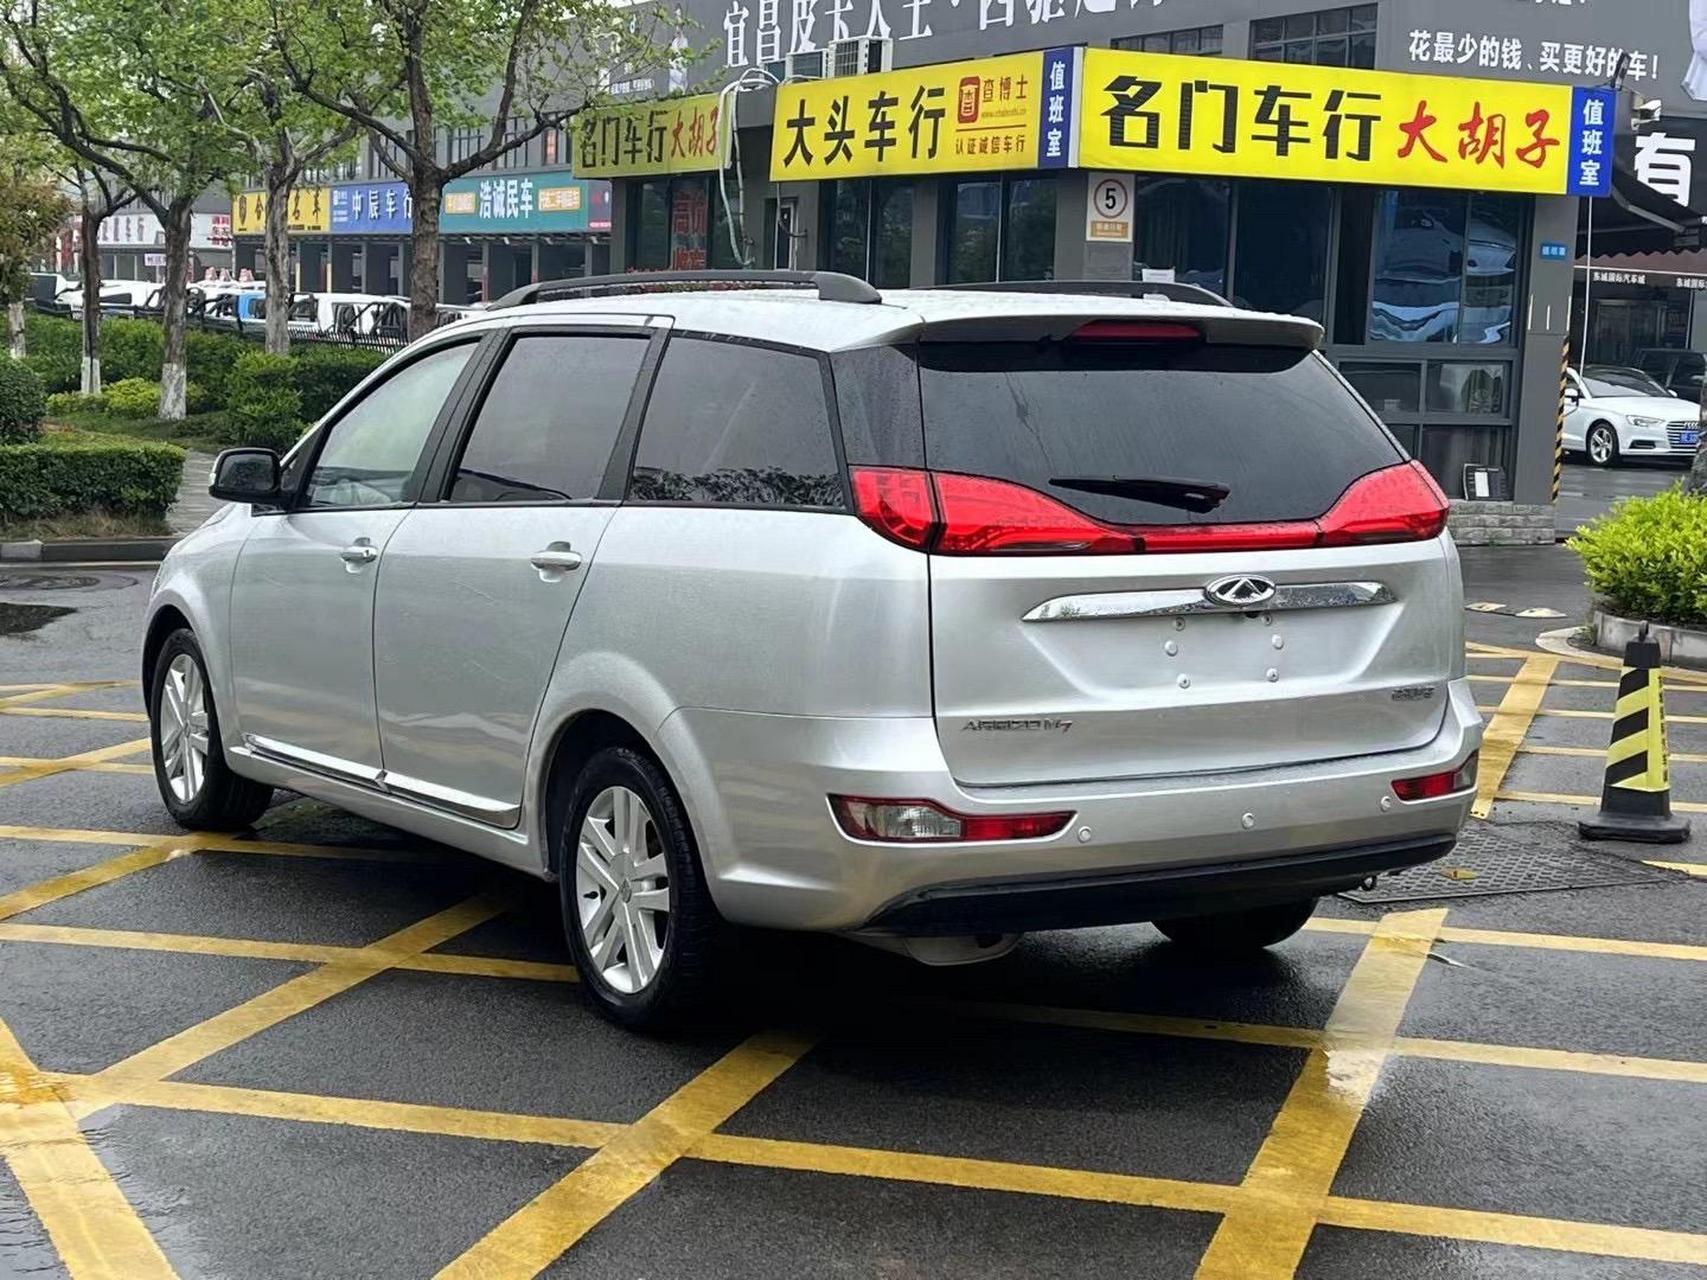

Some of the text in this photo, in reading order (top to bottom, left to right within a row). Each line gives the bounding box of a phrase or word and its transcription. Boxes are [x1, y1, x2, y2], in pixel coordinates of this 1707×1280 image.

[783, 85, 945, 167] 大头车行
[983, 74, 1029, 102] 查博士
[1046, 61, 1066, 157] 值班室
[1100, 75, 1561, 169] 名门车行 大胡子
[955, 134, 1026, 155] 认证诚信车行
[1578, 98, 1605, 186] 值班室
[1634, 132, 1696, 208] 有
[1105, 188, 1117, 210] 5
[1676, 277, 1707, 289] 东城国际
